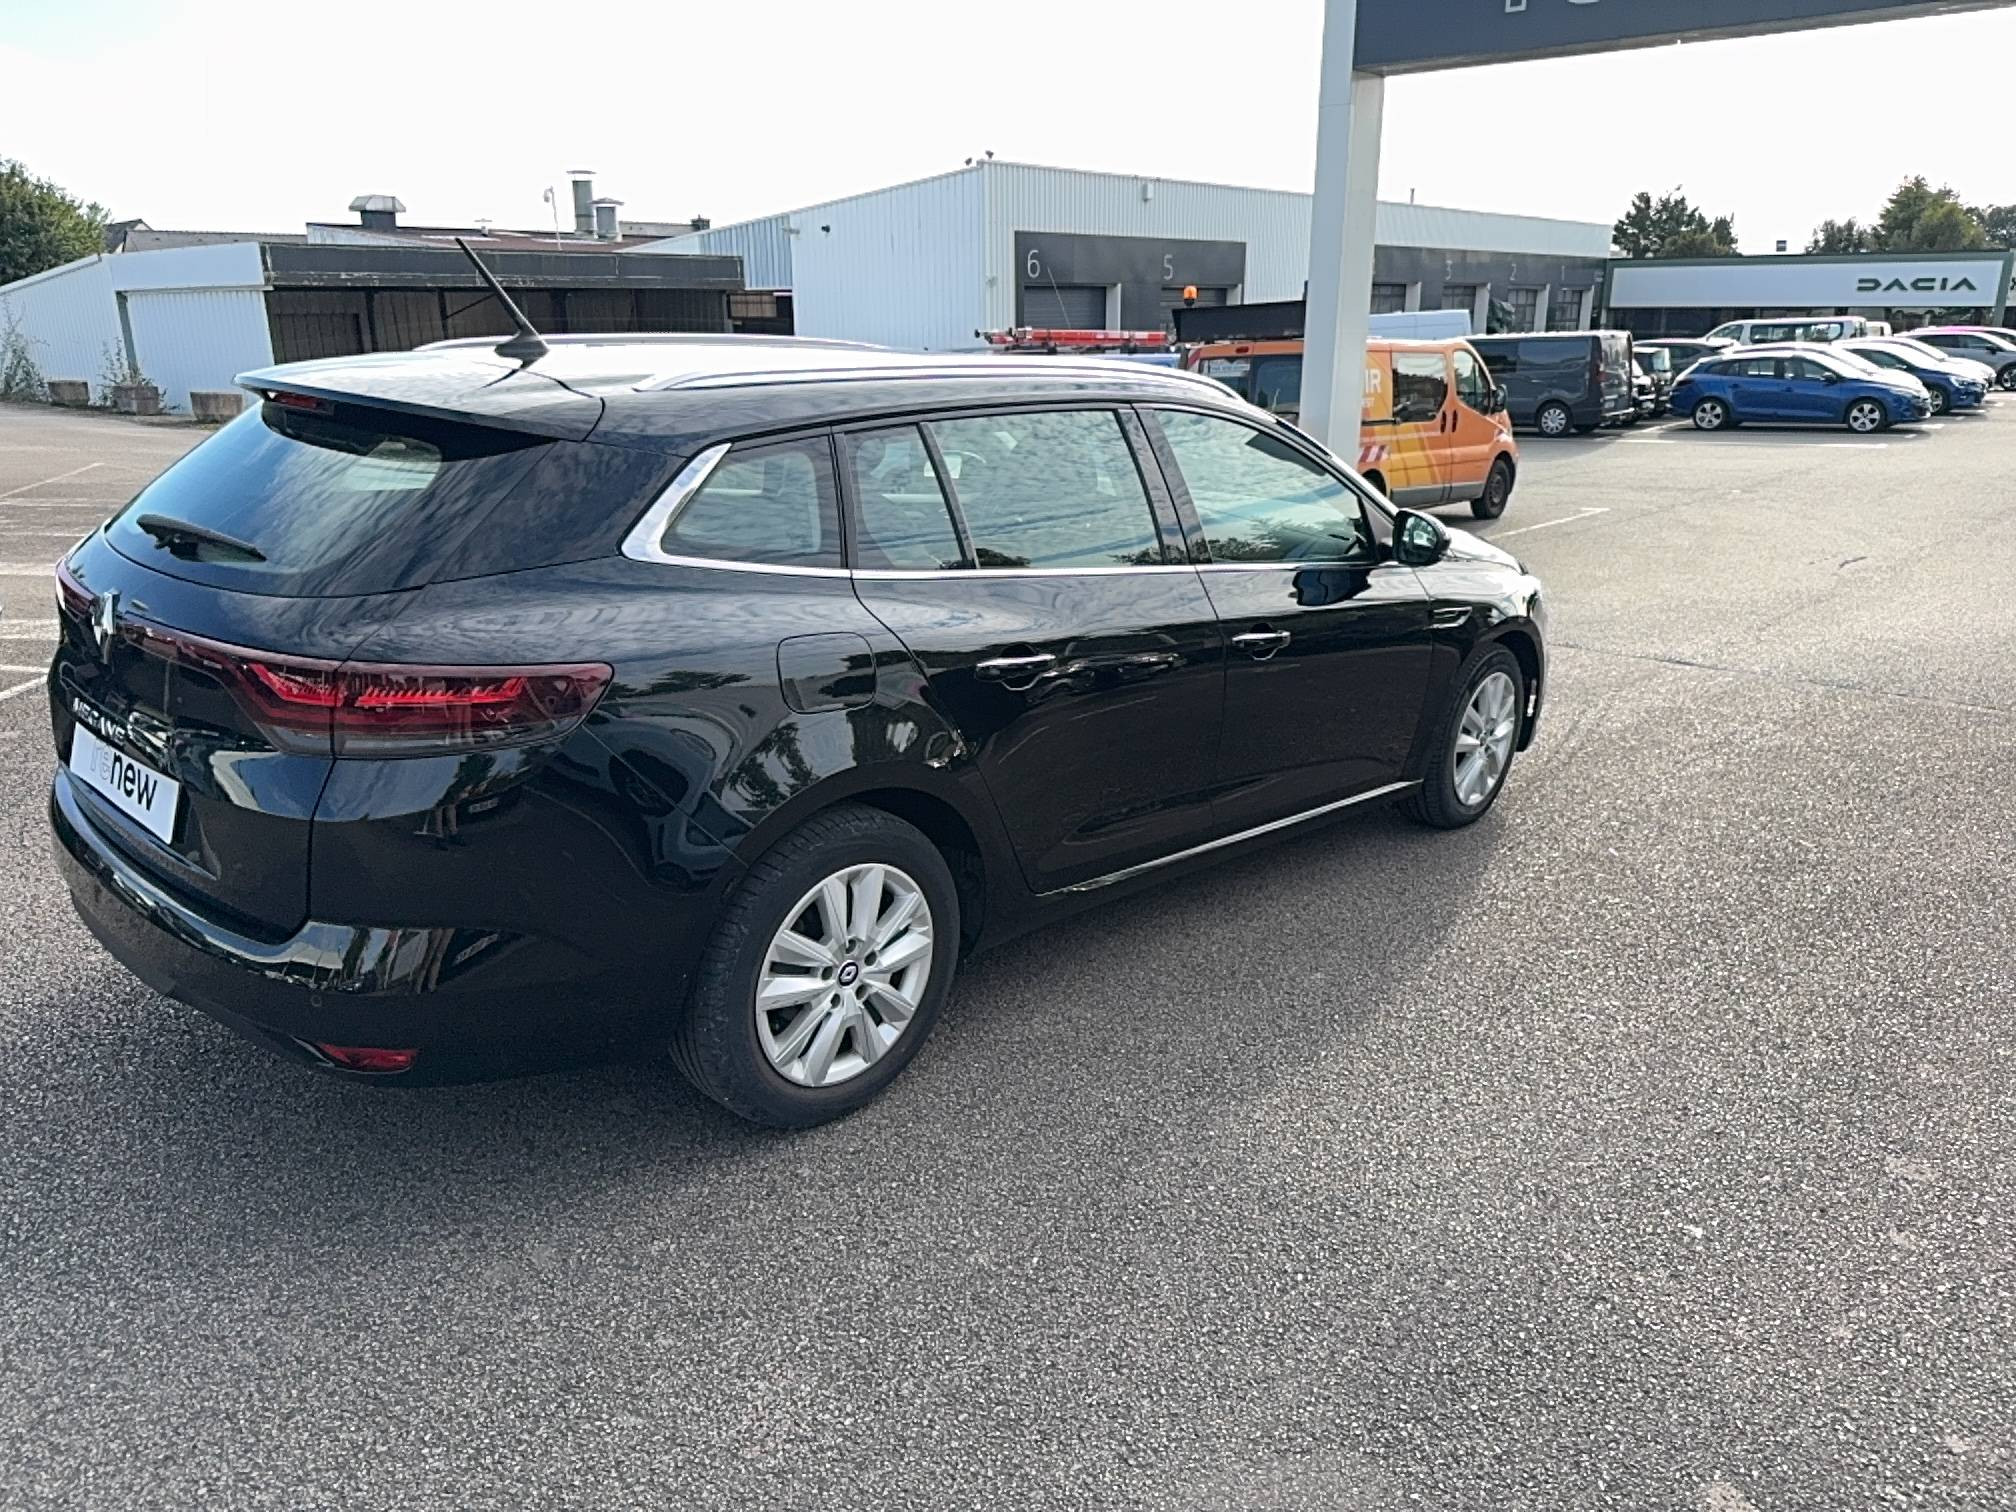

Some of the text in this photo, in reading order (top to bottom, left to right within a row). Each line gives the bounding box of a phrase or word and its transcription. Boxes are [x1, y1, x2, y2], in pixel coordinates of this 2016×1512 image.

[1027, 249, 1041, 278] 6
[1163, 254, 1174, 280] 5
[1445, 259, 1453, 281] 3
[1509, 263, 1517, 281] 2
[1856, 277, 1977, 292] DACIA
